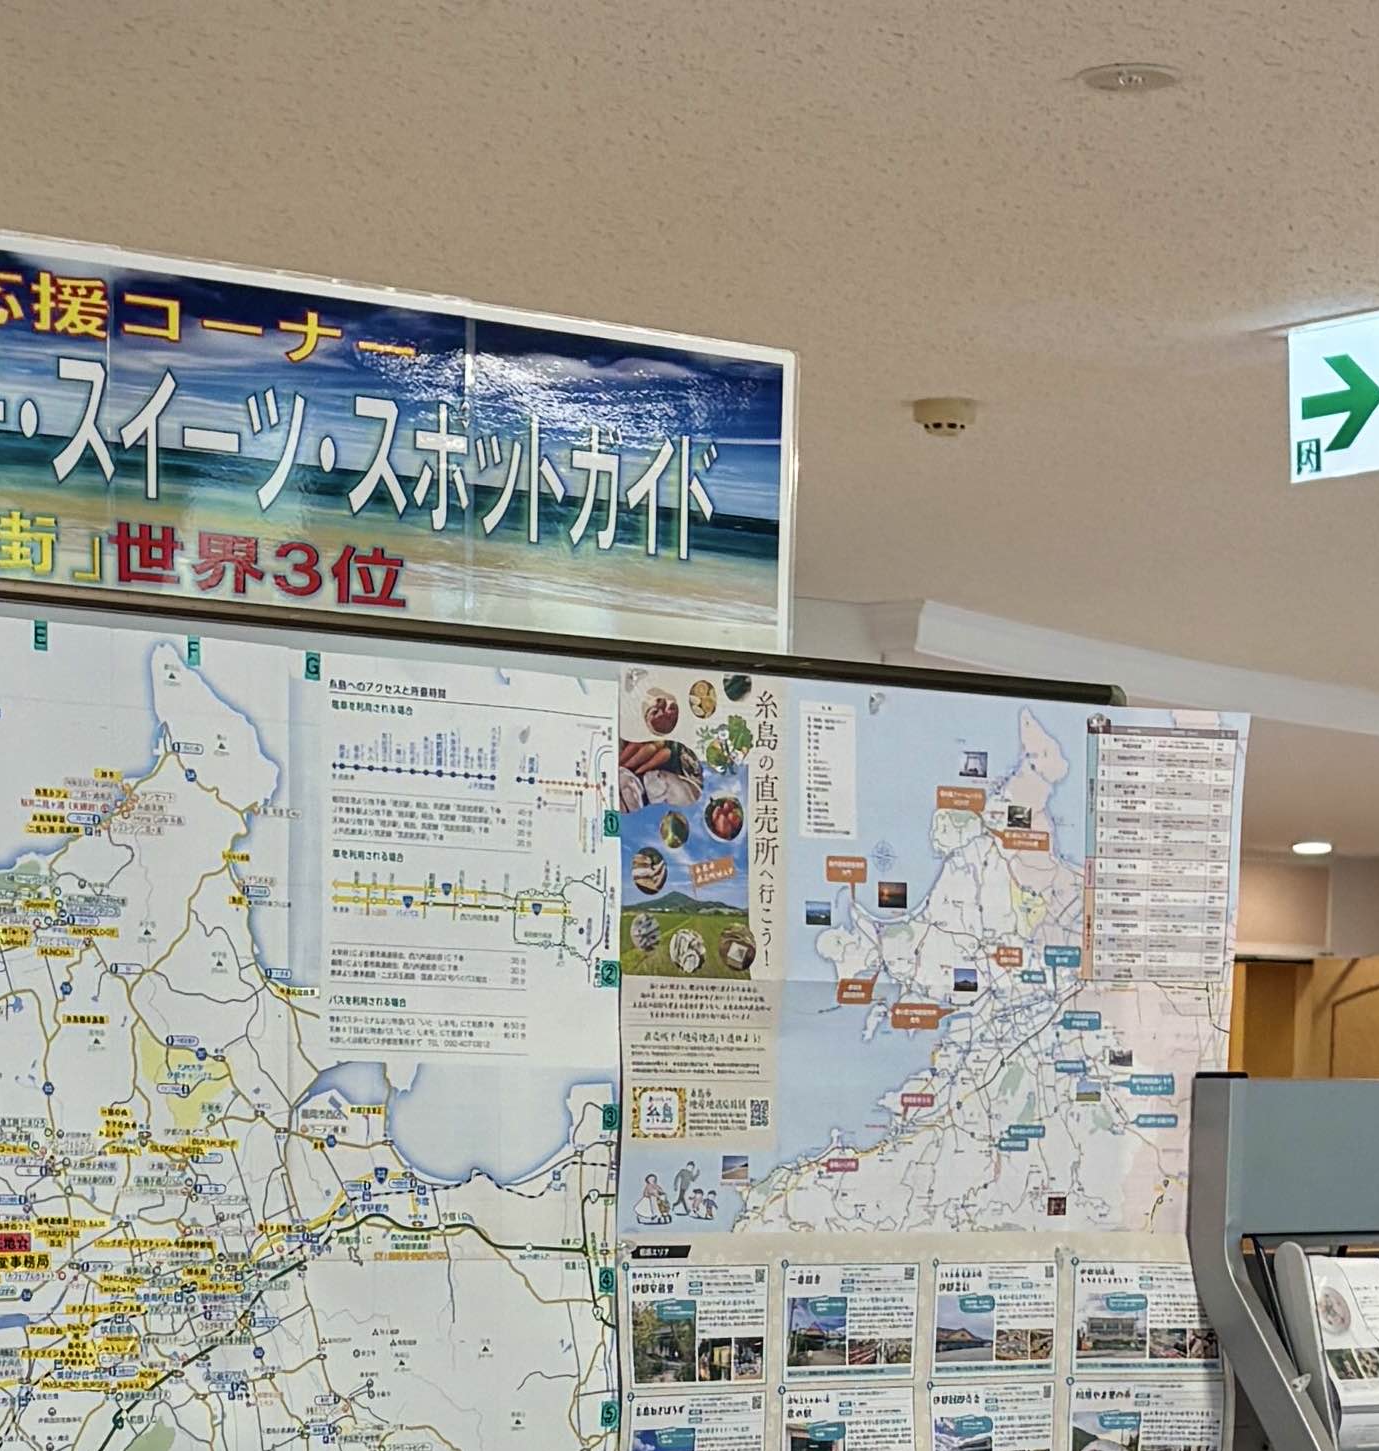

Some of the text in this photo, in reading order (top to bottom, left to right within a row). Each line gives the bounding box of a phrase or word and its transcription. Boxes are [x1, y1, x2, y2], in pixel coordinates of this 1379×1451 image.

[35, 626, 46, 644] E
[188, 640, 199, 658] F
[306, 656, 319, 675] G
[753, 689, 780, 967] 糸島の直売所へ行こう！
